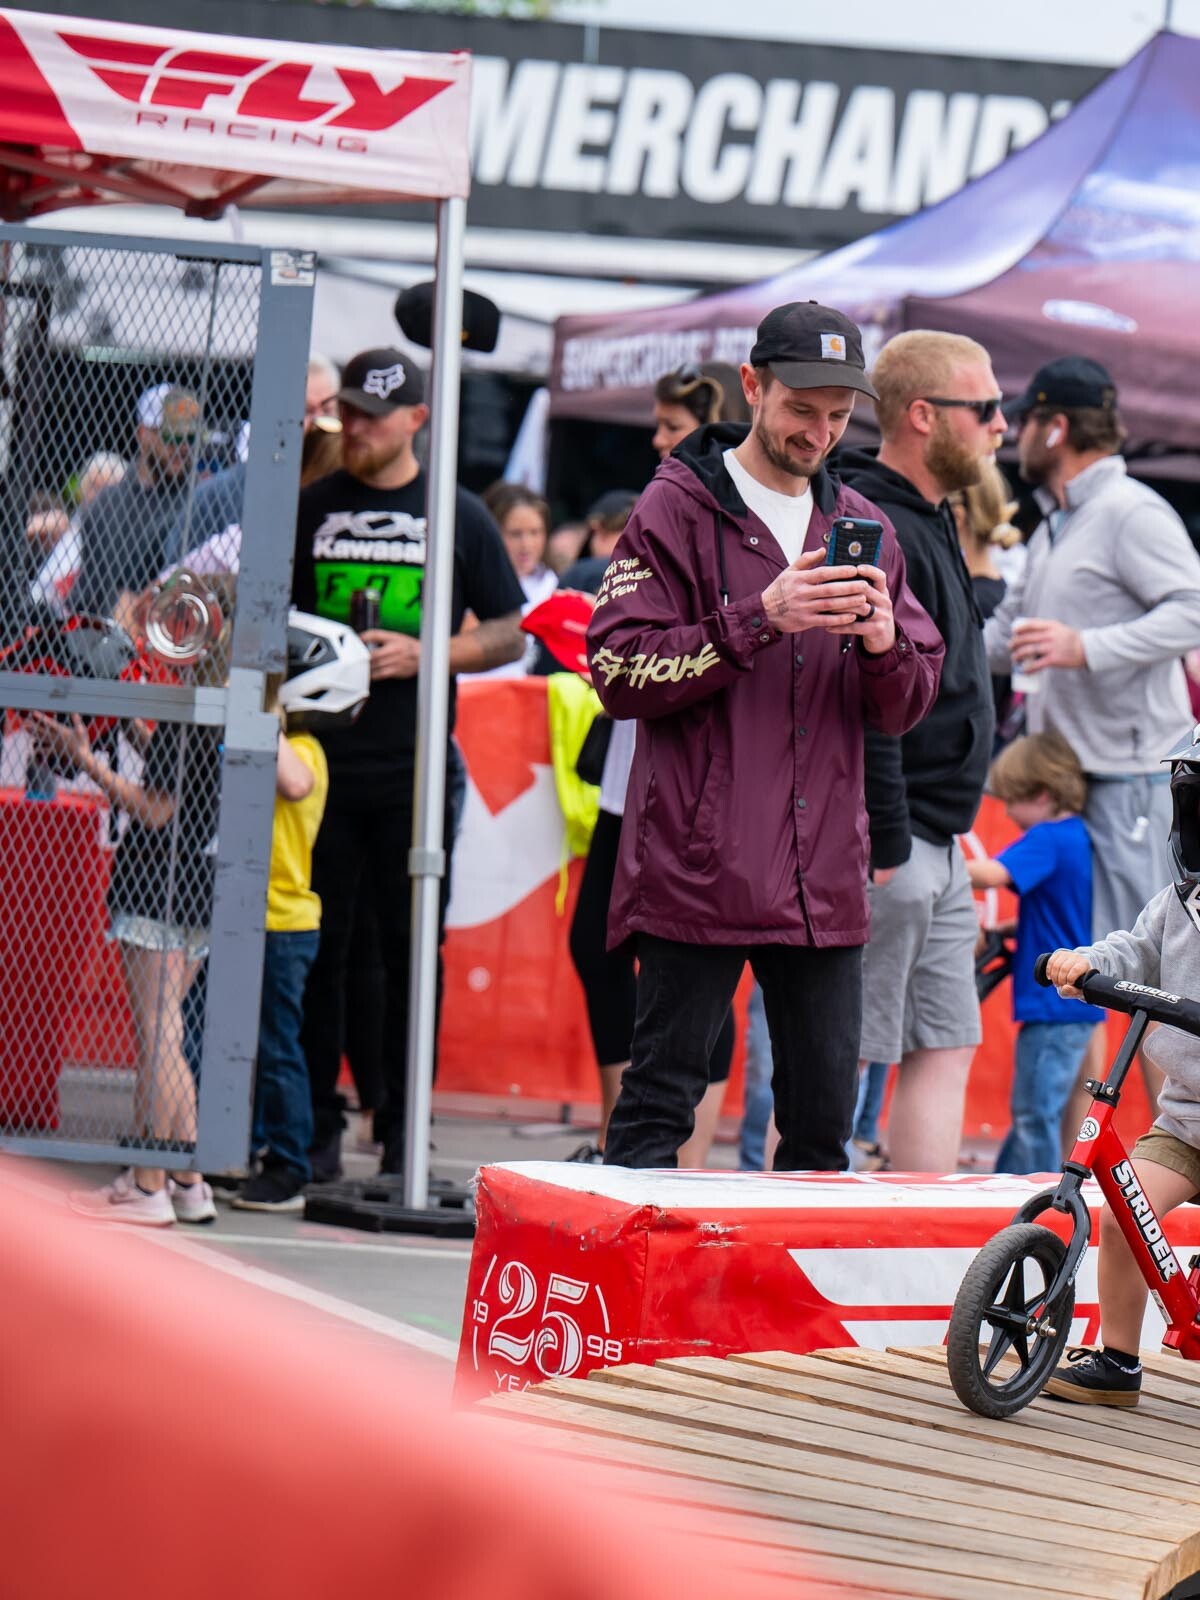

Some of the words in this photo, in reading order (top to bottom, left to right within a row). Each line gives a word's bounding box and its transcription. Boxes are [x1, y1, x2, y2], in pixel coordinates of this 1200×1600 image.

[56, 32, 456, 131] FLY
[136, 111, 367, 153] RACING
[470, 56, 1073, 215] MERCHAND
[312, 536, 426, 564] Kawasa
[617, 557, 640, 571] THE
[610, 582, 638, 599] FEW
[611, 567, 653, 586] RULES
[1113, 980, 1183, 1004] STRIDER
[1111, 1160, 1179, 1283] STRIDER
[472, 1299, 489, 1324] 19
[488, 1260, 590, 1379] 25
[586, 1334, 623, 1362] 98
[495, 1369, 534, 1393] YEA
